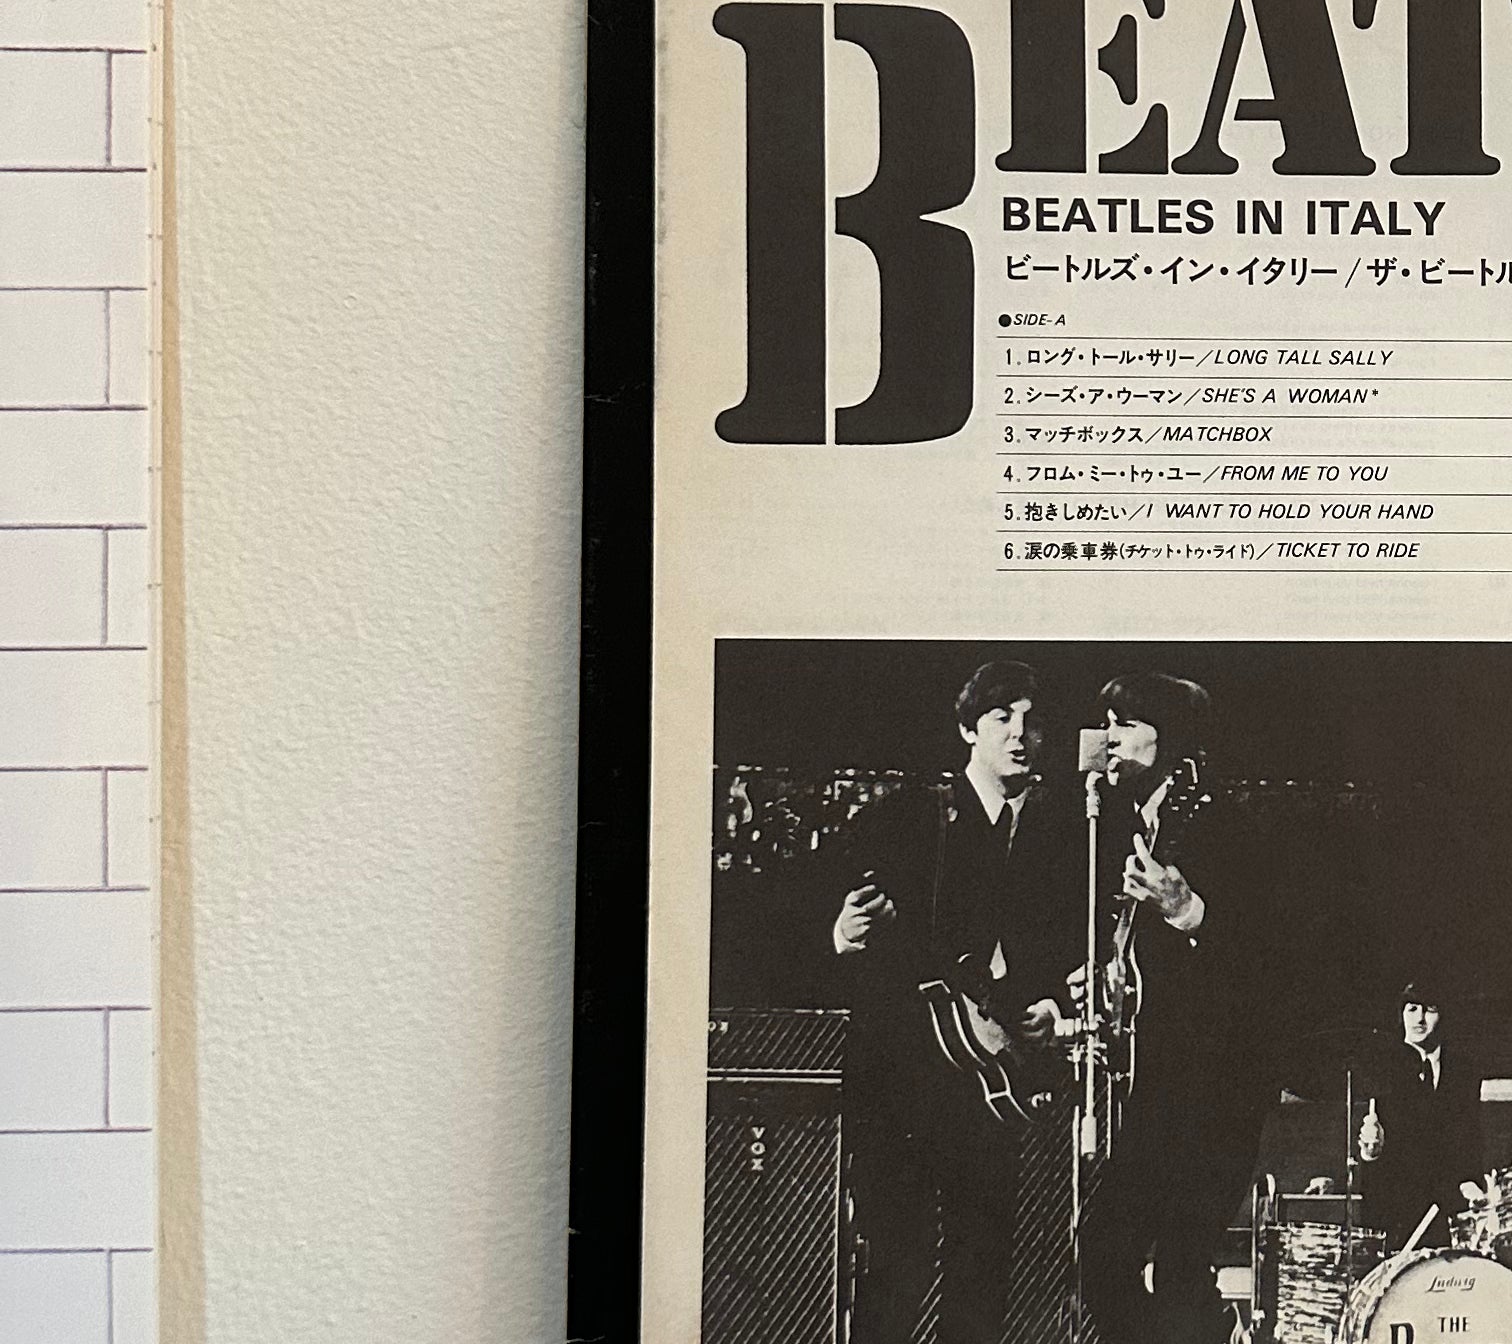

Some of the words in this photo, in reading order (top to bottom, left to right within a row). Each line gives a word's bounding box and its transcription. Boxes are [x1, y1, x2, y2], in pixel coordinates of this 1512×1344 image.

[1002, 196, 1214, 235] BEATLES
[1236, 199, 1283, 235] IN
[1306, 200, 1446, 236] ITALY
[1214, 349, 1269, 365] LONG
[1277, 349, 1322, 365] TALL
[1328, 349, 1394, 366] SALLY
[1199, 387, 1257, 404] SHE'S
[1261, 388, 1276, 404] A
[1162, 426, 1273, 442] MATCHBOX
[1220, 465, 1275, 481] FROM
[1280, 465, 1311, 481] ME
[1316, 465, 1340, 482] TO
[1349, 465, 1389, 482] YOU
[1146, 503, 1154, 518] I
[1165, 503, 1225, 519] WANT
[1228, 503, 1252, 519] TO
[1257, 503, 1311, 520] HOLD
[1320, 503, 1372, 520] YOUR
[1377, 504, 1434, 520] HAND
[1276, 542, 1342, 558] TICKET
[1346, 542, 1370, 559] TO
[1375, 542, 1421, 558] RIDE
[751, 1126, 766, 1171] VOX
[1424, 1275, 1476, 1294] Ludwig
[1438, 1316, 1471, 1333] THE
